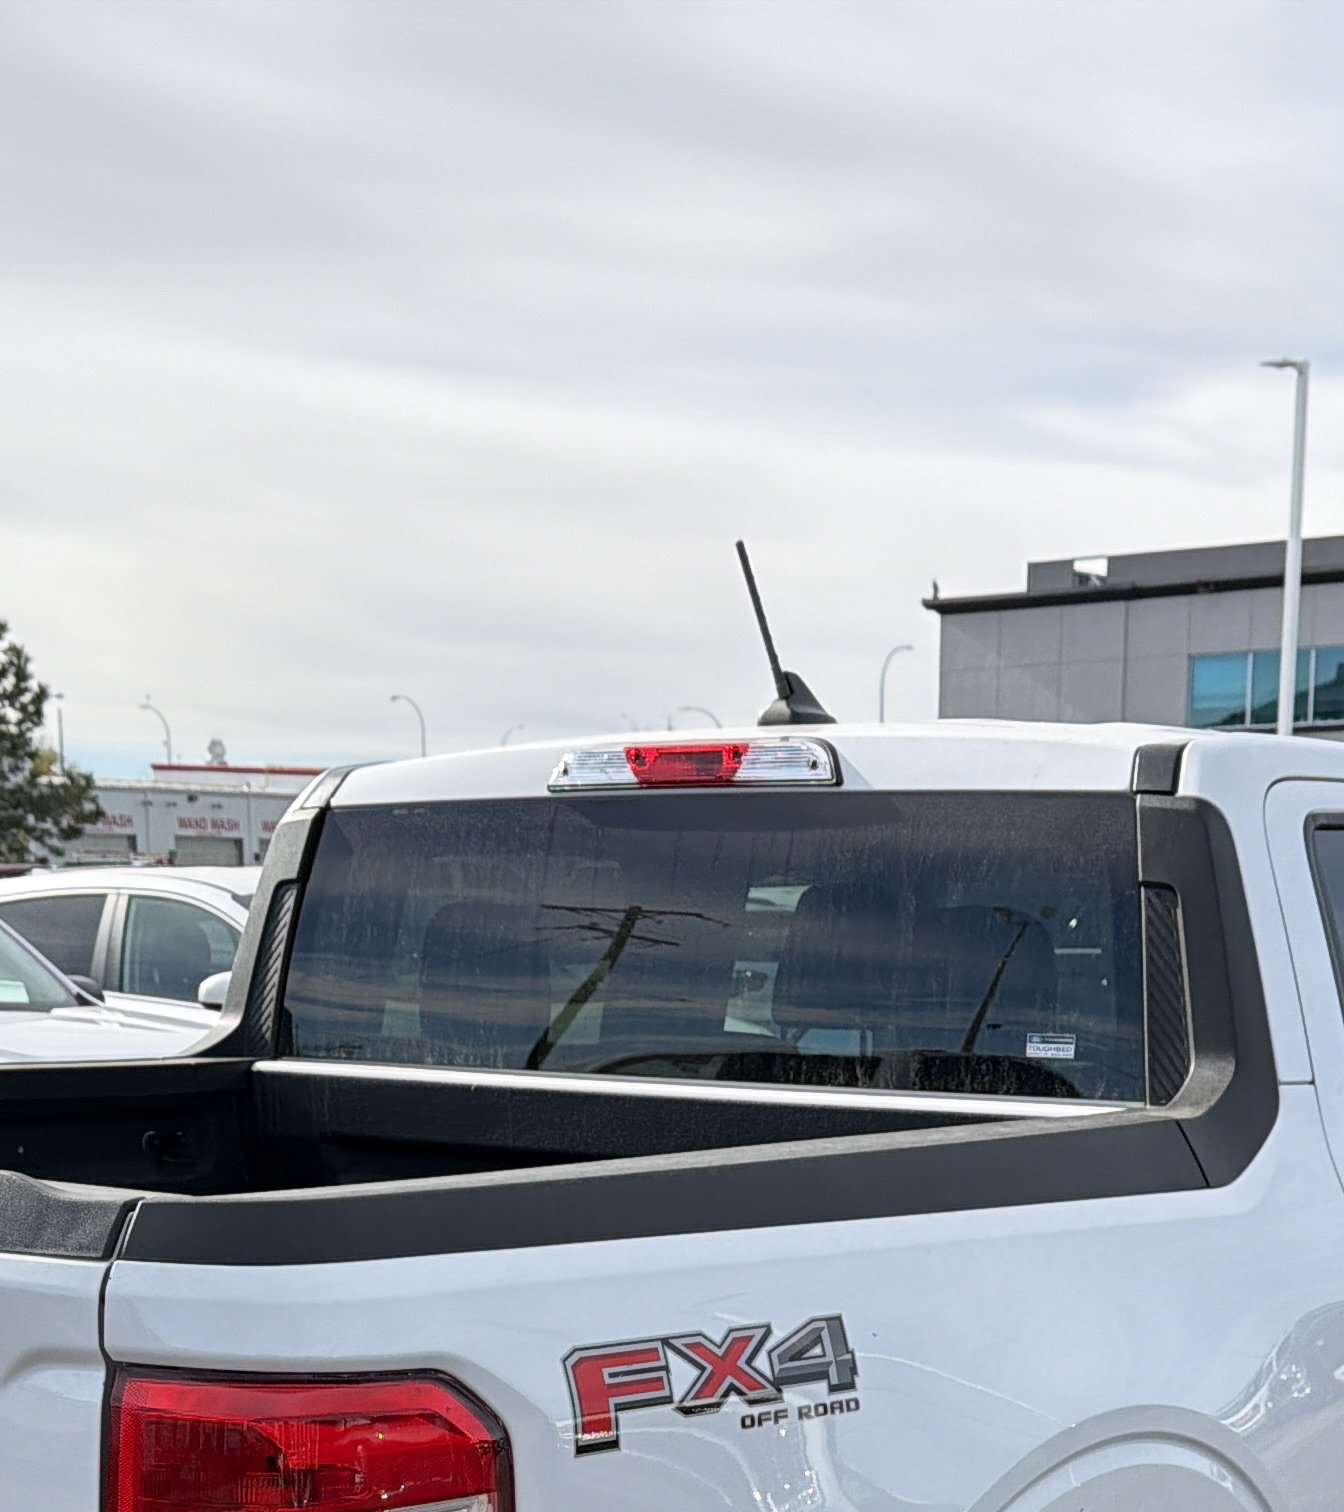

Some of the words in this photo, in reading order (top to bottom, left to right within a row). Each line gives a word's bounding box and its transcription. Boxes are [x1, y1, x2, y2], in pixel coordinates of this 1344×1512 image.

[560, 1312, 860, 1459] FX4
[741, 1408, 788, 1430] OFF
[797, 1397, 860, 1421] ROAD
